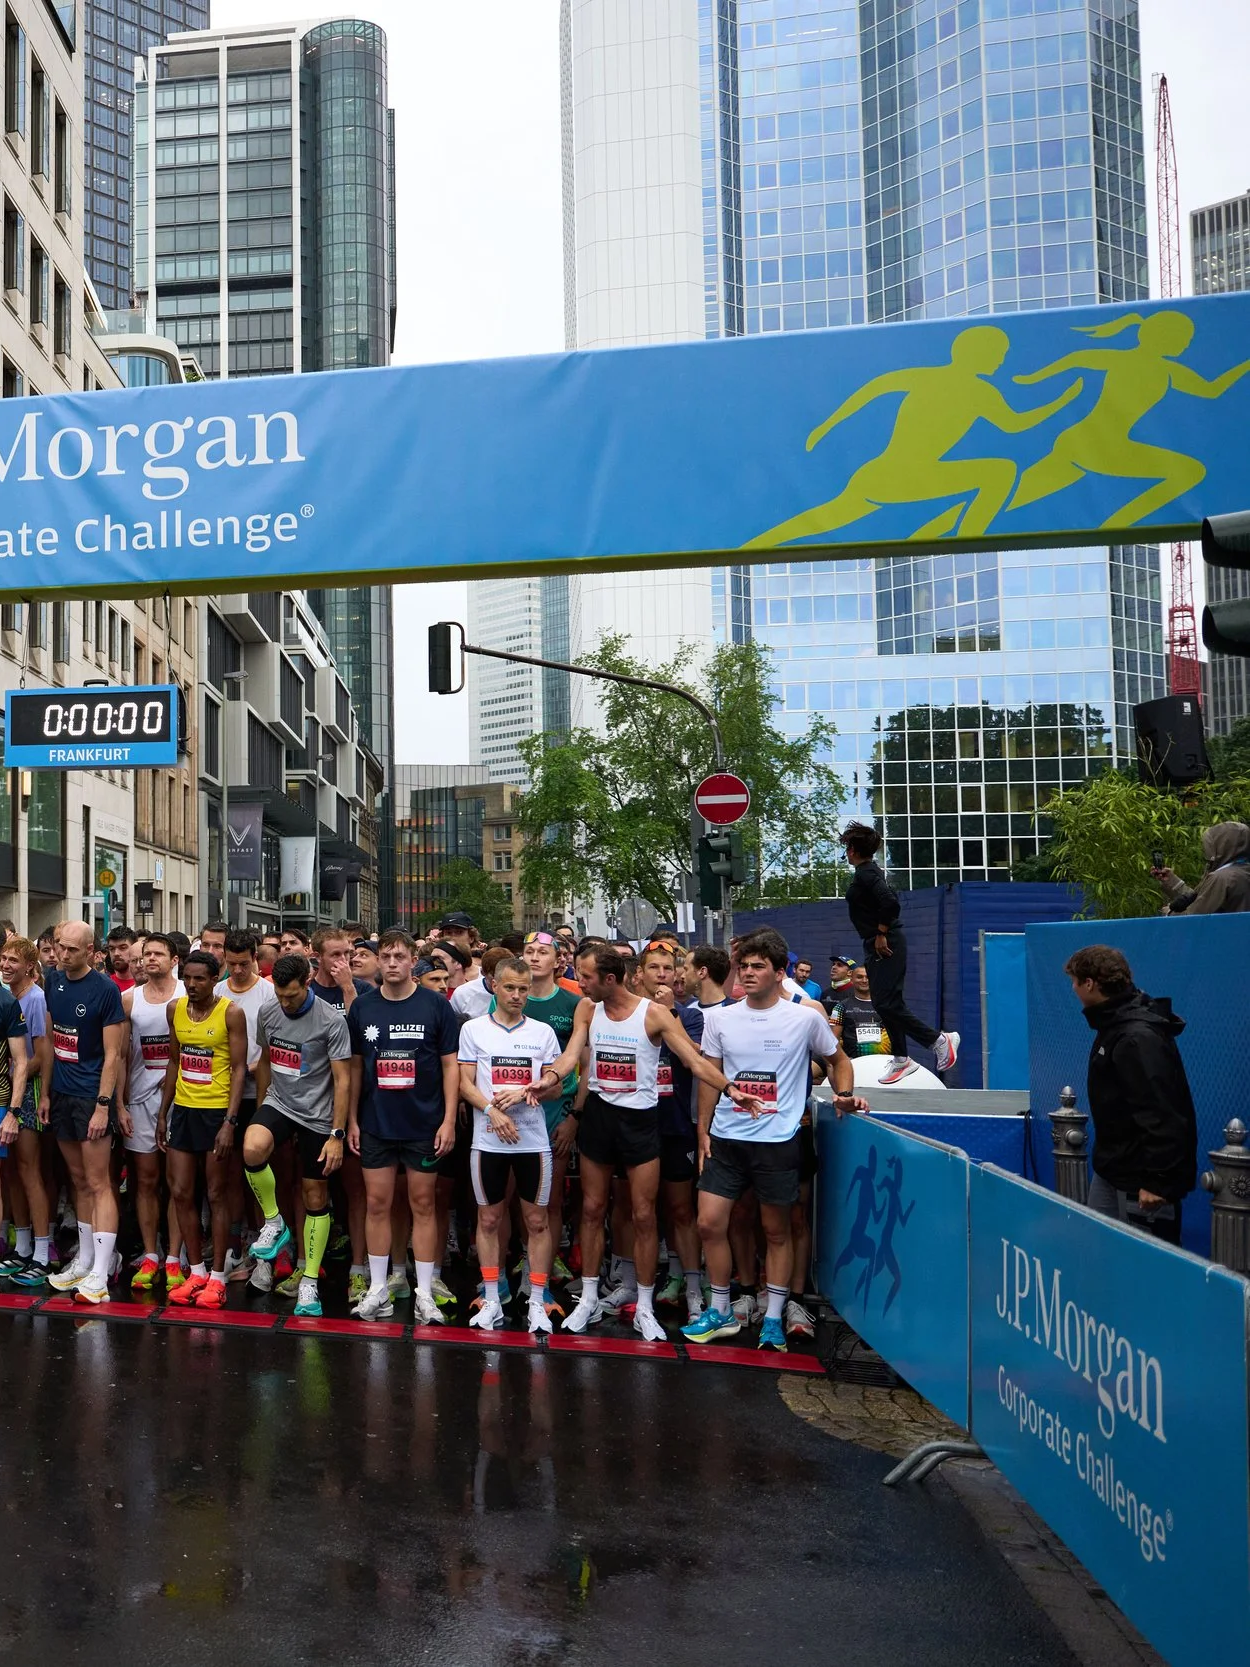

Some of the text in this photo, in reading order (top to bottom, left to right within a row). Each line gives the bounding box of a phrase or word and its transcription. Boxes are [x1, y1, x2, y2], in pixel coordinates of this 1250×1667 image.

[43, 701, 164, 737] 0:00:00
[49, 748, 130, 762] FRANKFURT
[102, 872, 111, 884] H
[389, 1024, 425, 1032] POLIZEI
[181, 1056, 210, 1069] 11803
[270, 1048, 299, 1064] 10710
[378, 1062, 413, 1072] 11948
[599, 1064, 633, 1076] 12121
[494, 1069, 531, 1080] 10393
[736, 1083, 775, 1096] 11554
[997, 1364, 1072, 1466] Corporate
